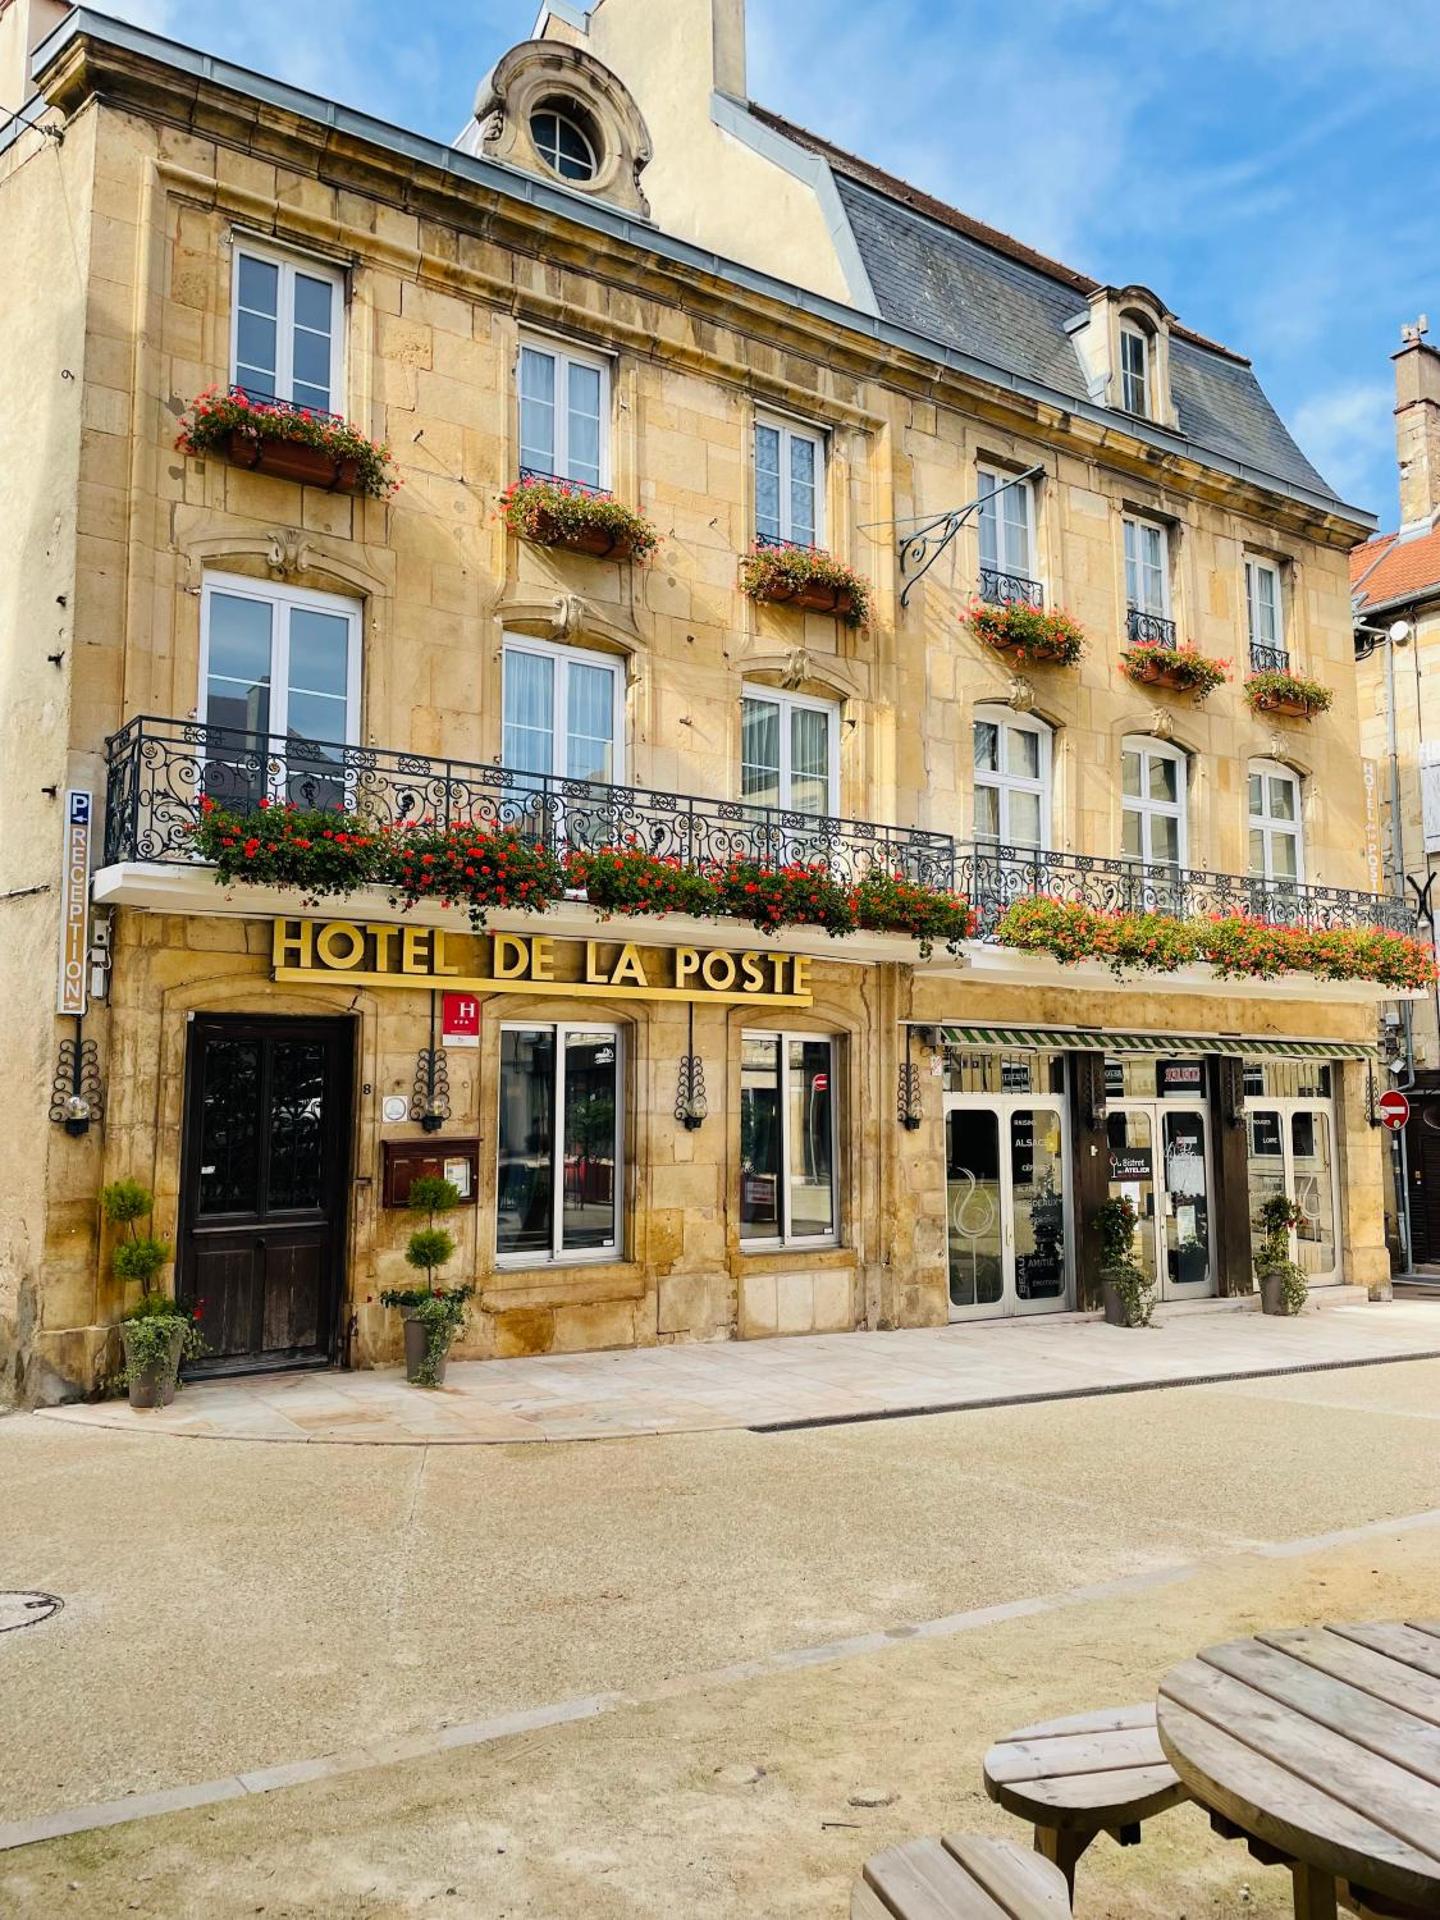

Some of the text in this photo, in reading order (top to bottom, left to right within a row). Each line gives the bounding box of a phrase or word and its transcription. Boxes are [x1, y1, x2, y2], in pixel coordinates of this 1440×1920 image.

[72, 796, 88, 815] P
[1364, 763, 1374, 820] HOTEL
[66, 828, 87, 998] RECEPTION
[272, 917, 812, 995] HOTEL DE LA POSTE
[459, 1002, 475, 1018] H
[362, 1083, 371, 1095] 8
